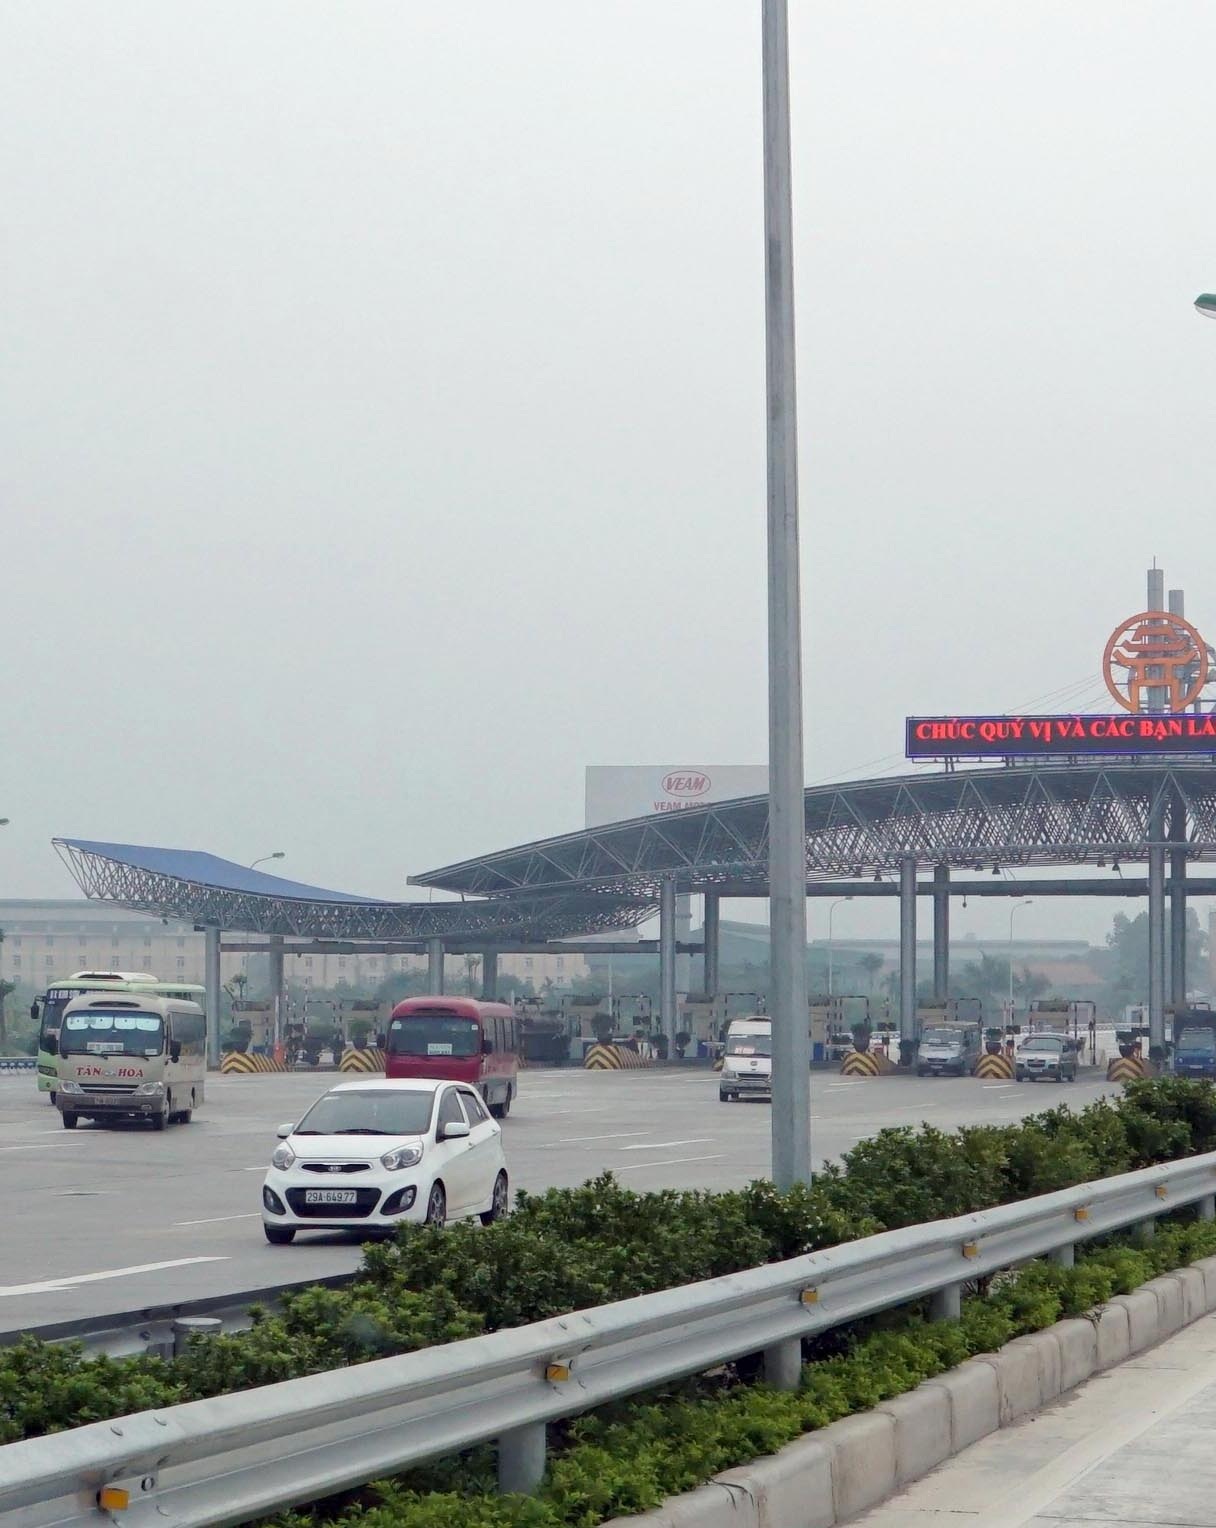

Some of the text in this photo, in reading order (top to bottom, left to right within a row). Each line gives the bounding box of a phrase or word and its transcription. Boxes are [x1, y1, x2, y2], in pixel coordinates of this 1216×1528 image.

[916, 718, 976, 740] CHÚC
[979, 717, 1024, 743] QUÝ
[1029, 721, 1052, 743] VỊ
[1056, 716, 1086, 738] VÀ
[1090, 715, 1135, 737] CÁC
[1139, 720, 1182, 741] BẠN
[666, 777, 705, 791] VEAM
